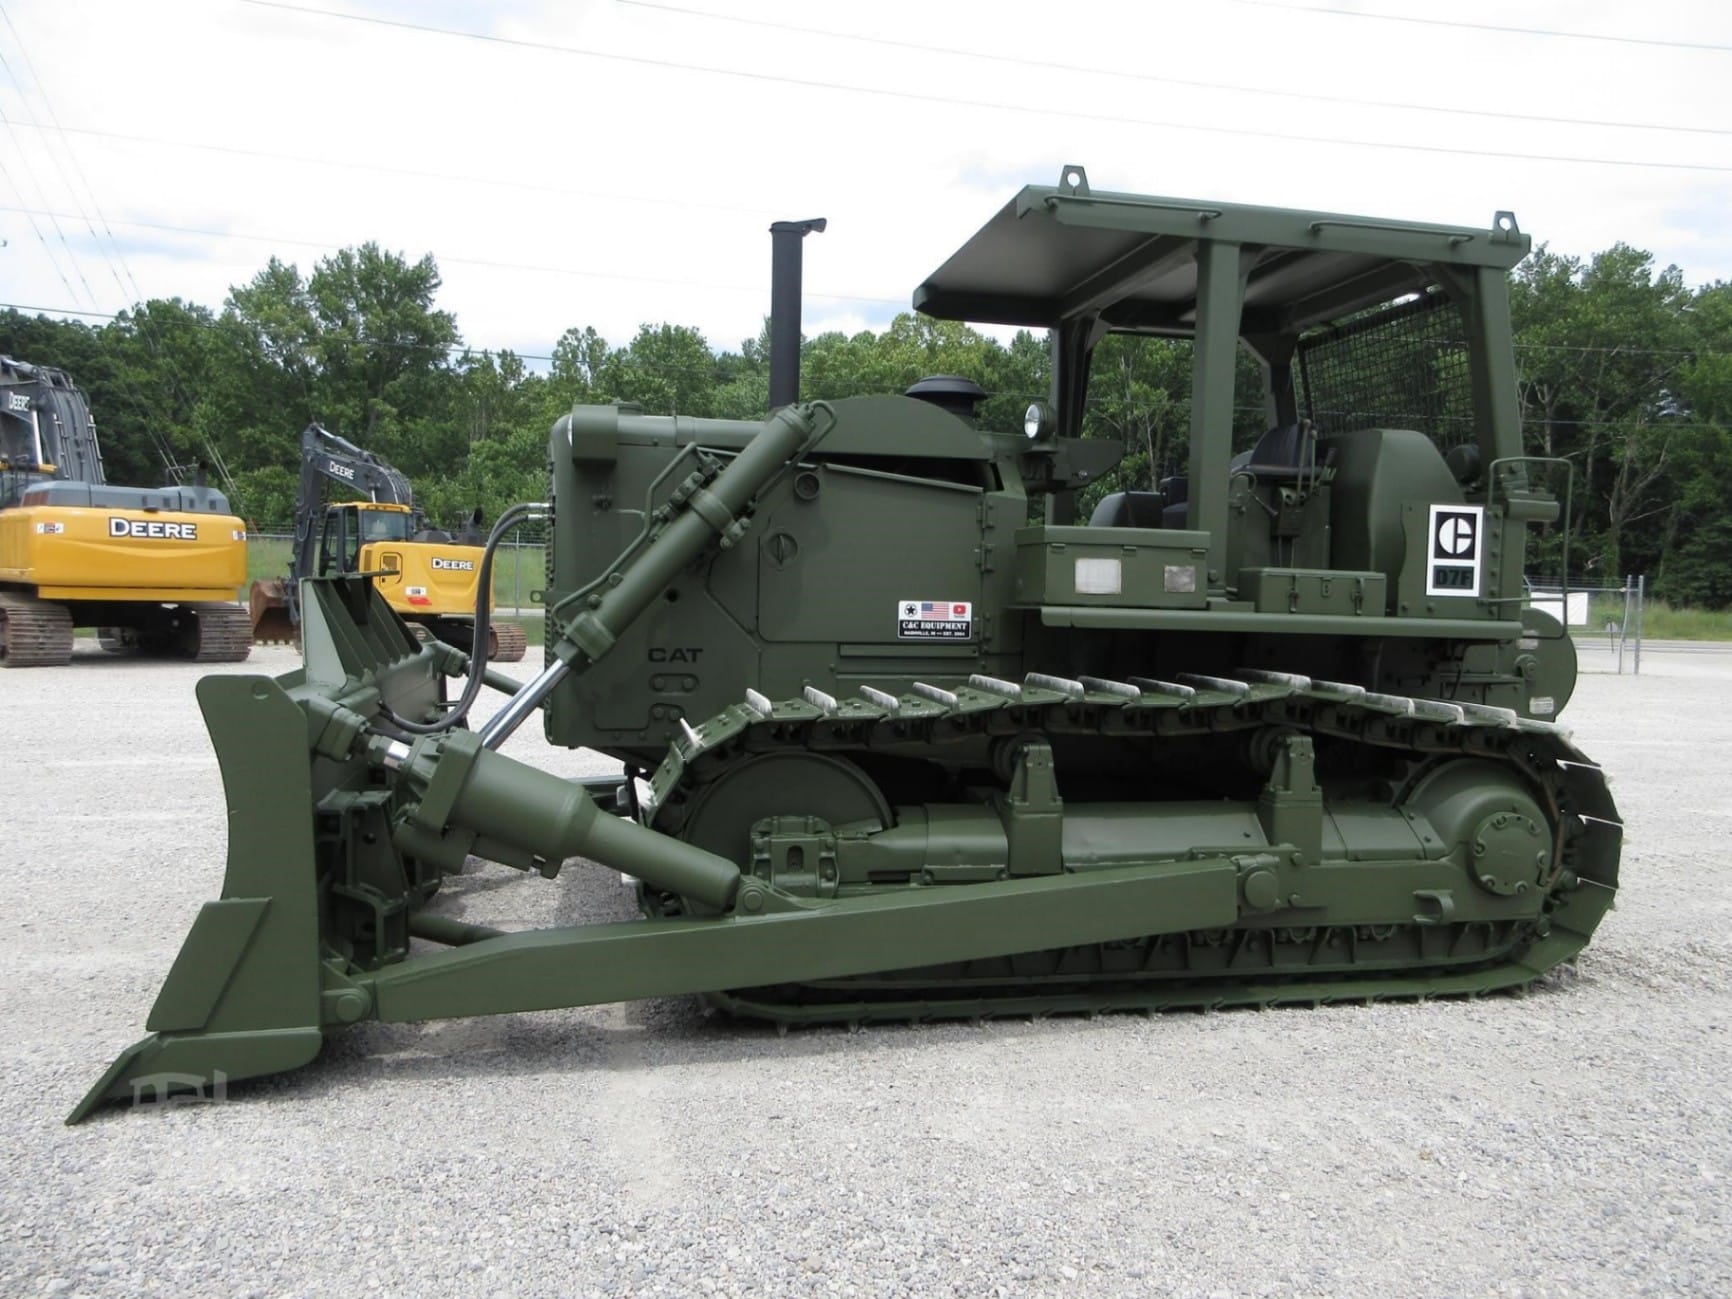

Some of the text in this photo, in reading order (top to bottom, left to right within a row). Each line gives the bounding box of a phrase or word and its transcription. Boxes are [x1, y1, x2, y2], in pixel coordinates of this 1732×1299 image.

[9, 391, 30, 411] DEERE
[330, 460, 354, 480] DEERE
[110, 517, 197, 540] DEERE
[432, 557, 474, 571] DEERE
[1435, 568, 1472, 586] D7F
[902, 621, 967, 631] C&C EQUIPMENT
[648, 648, 703, 663] CAT
